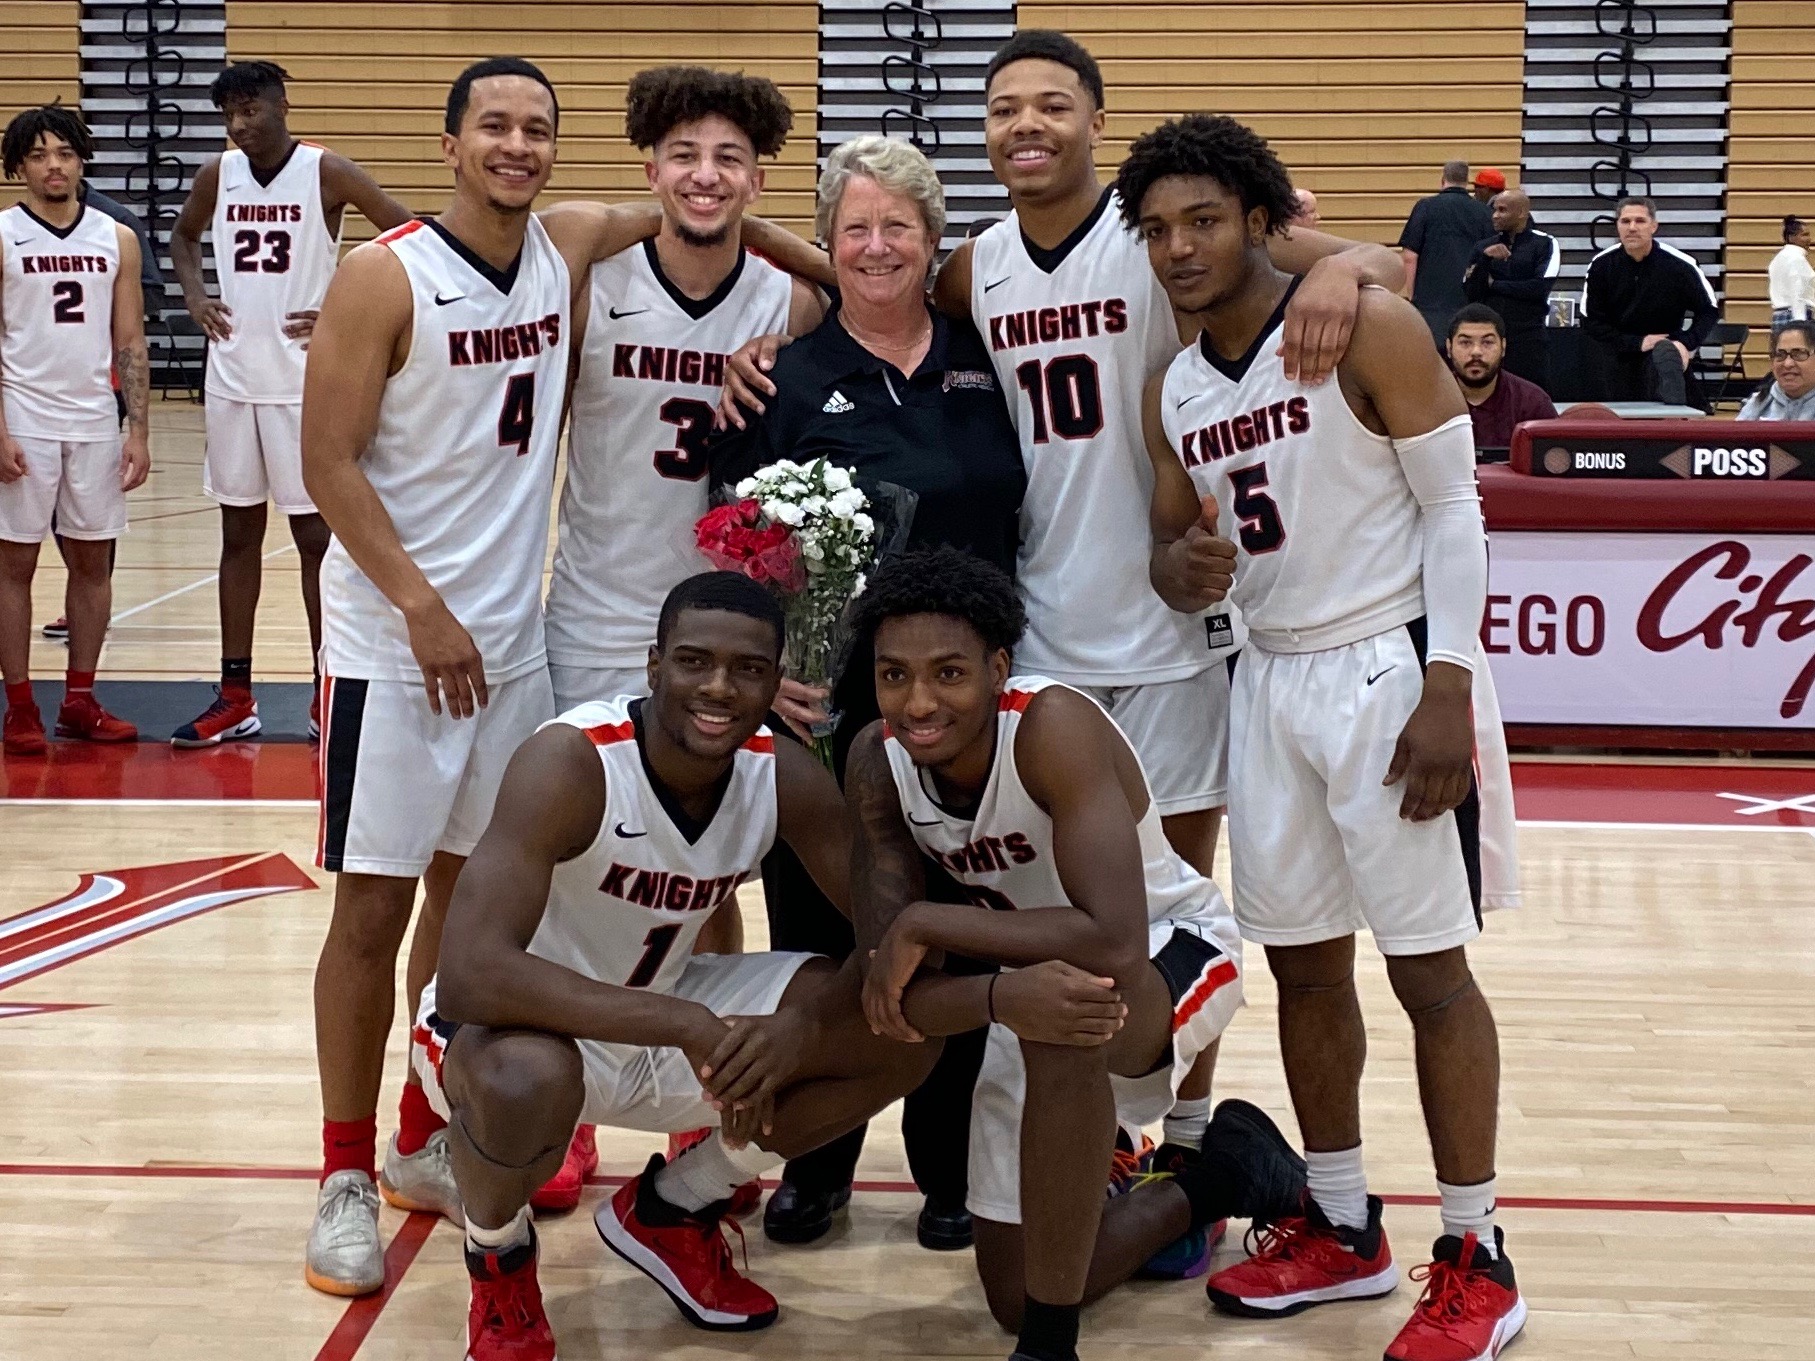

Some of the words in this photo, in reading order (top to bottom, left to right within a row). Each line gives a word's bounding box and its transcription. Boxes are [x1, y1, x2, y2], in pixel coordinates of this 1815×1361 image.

[227, 204, 301, 222] KNIGHTS
[22, 256, 108, 274] KNIGHTS
[234, 229, 292, 273] 23
[53, 281, 84, 323] 2
[990, 298, 1127, 351] KNIGHTS
[498, 371, 535, 457] 4
[1016, 353, 1103, 444] 10
[653, 397, 716, 482] 3
[1181, 396, 1310, 470] KNIGHTS
[1575, 452, 1626, 470] BONUS
[1694, 448, 1767, 476] POSS
[1228, 461, 1286, 556] 5
[1212, 618, 1227, 629] XL
[624, 923, 684, 988] 1
